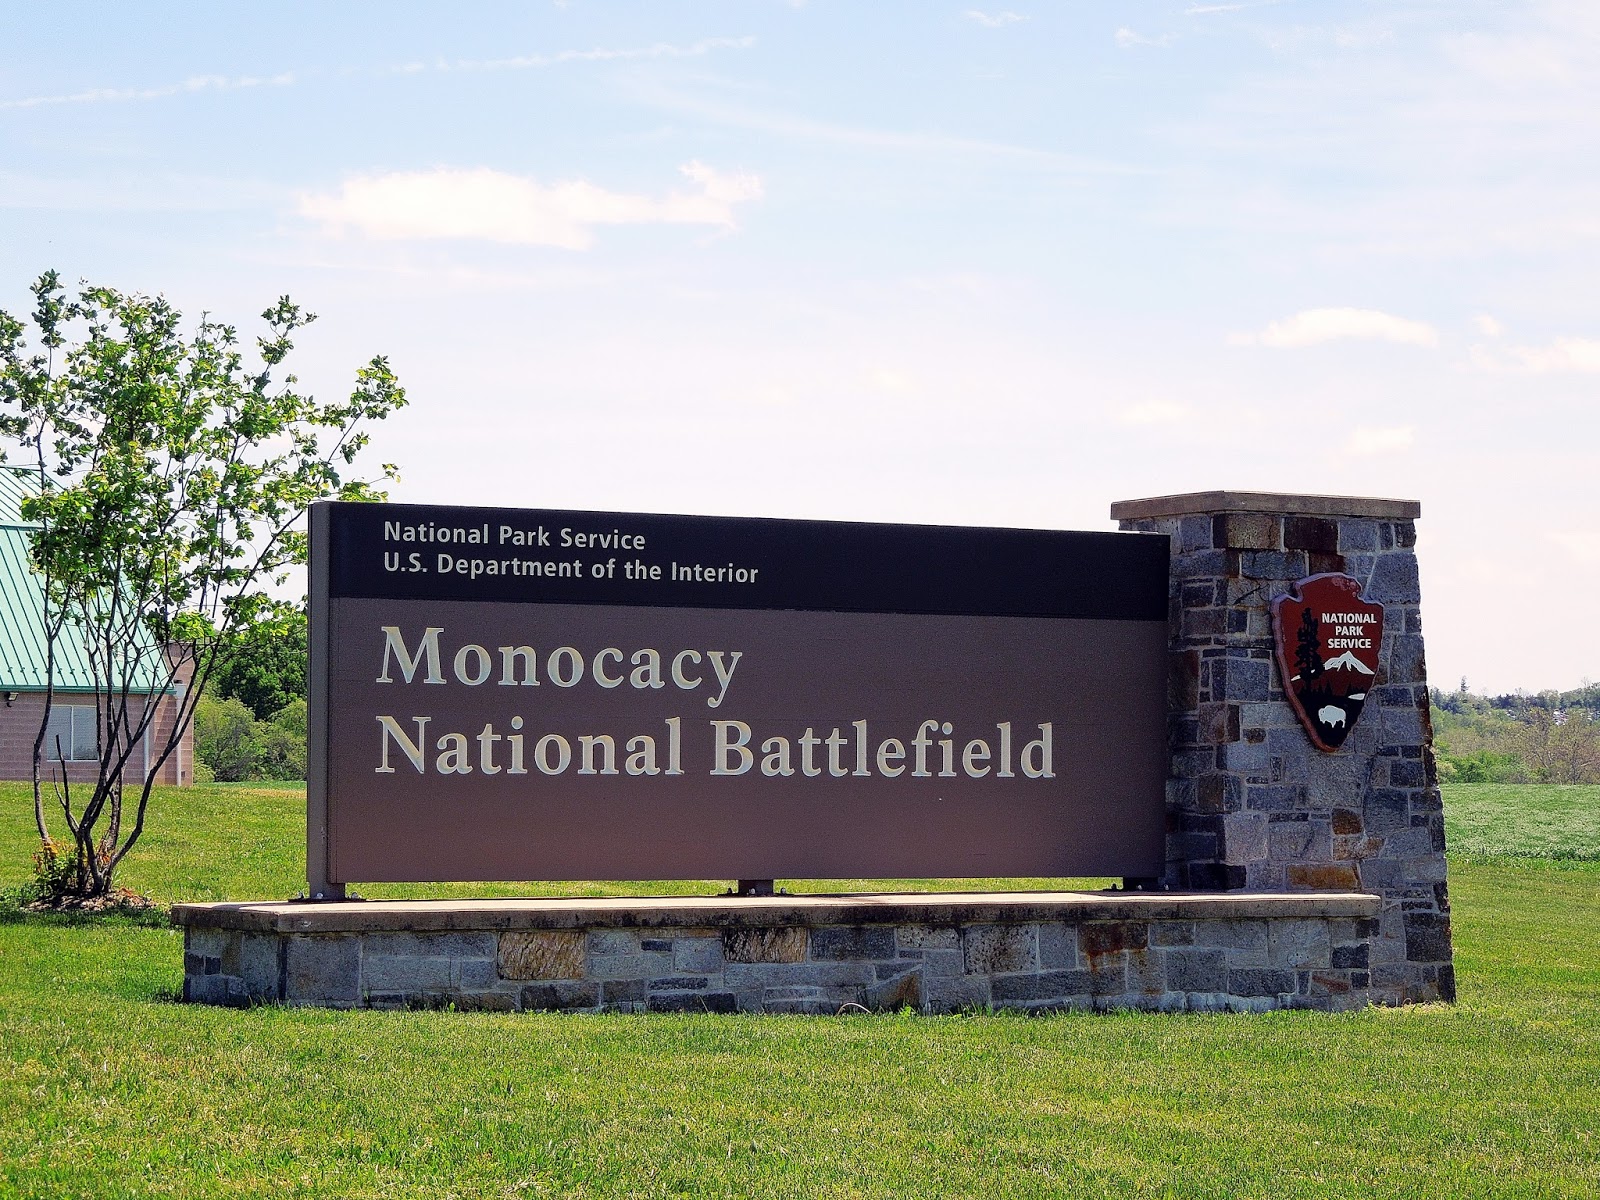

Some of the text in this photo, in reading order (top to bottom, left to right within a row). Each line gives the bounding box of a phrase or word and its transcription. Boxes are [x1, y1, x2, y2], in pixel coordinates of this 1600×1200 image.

[384, 520, 646, 550] National Park Service
[384, 551, 759, 583] U.S. Department of the Interior
[1321, 612, 1377, 624] NATIONAL
[1335, 625, 1364, 636] PARK
[1327, 638, 1372, 649] SERVICE
[375, 626, 743, 709] Monocacy
[374, 715, 1056, 779] National Battlefield
